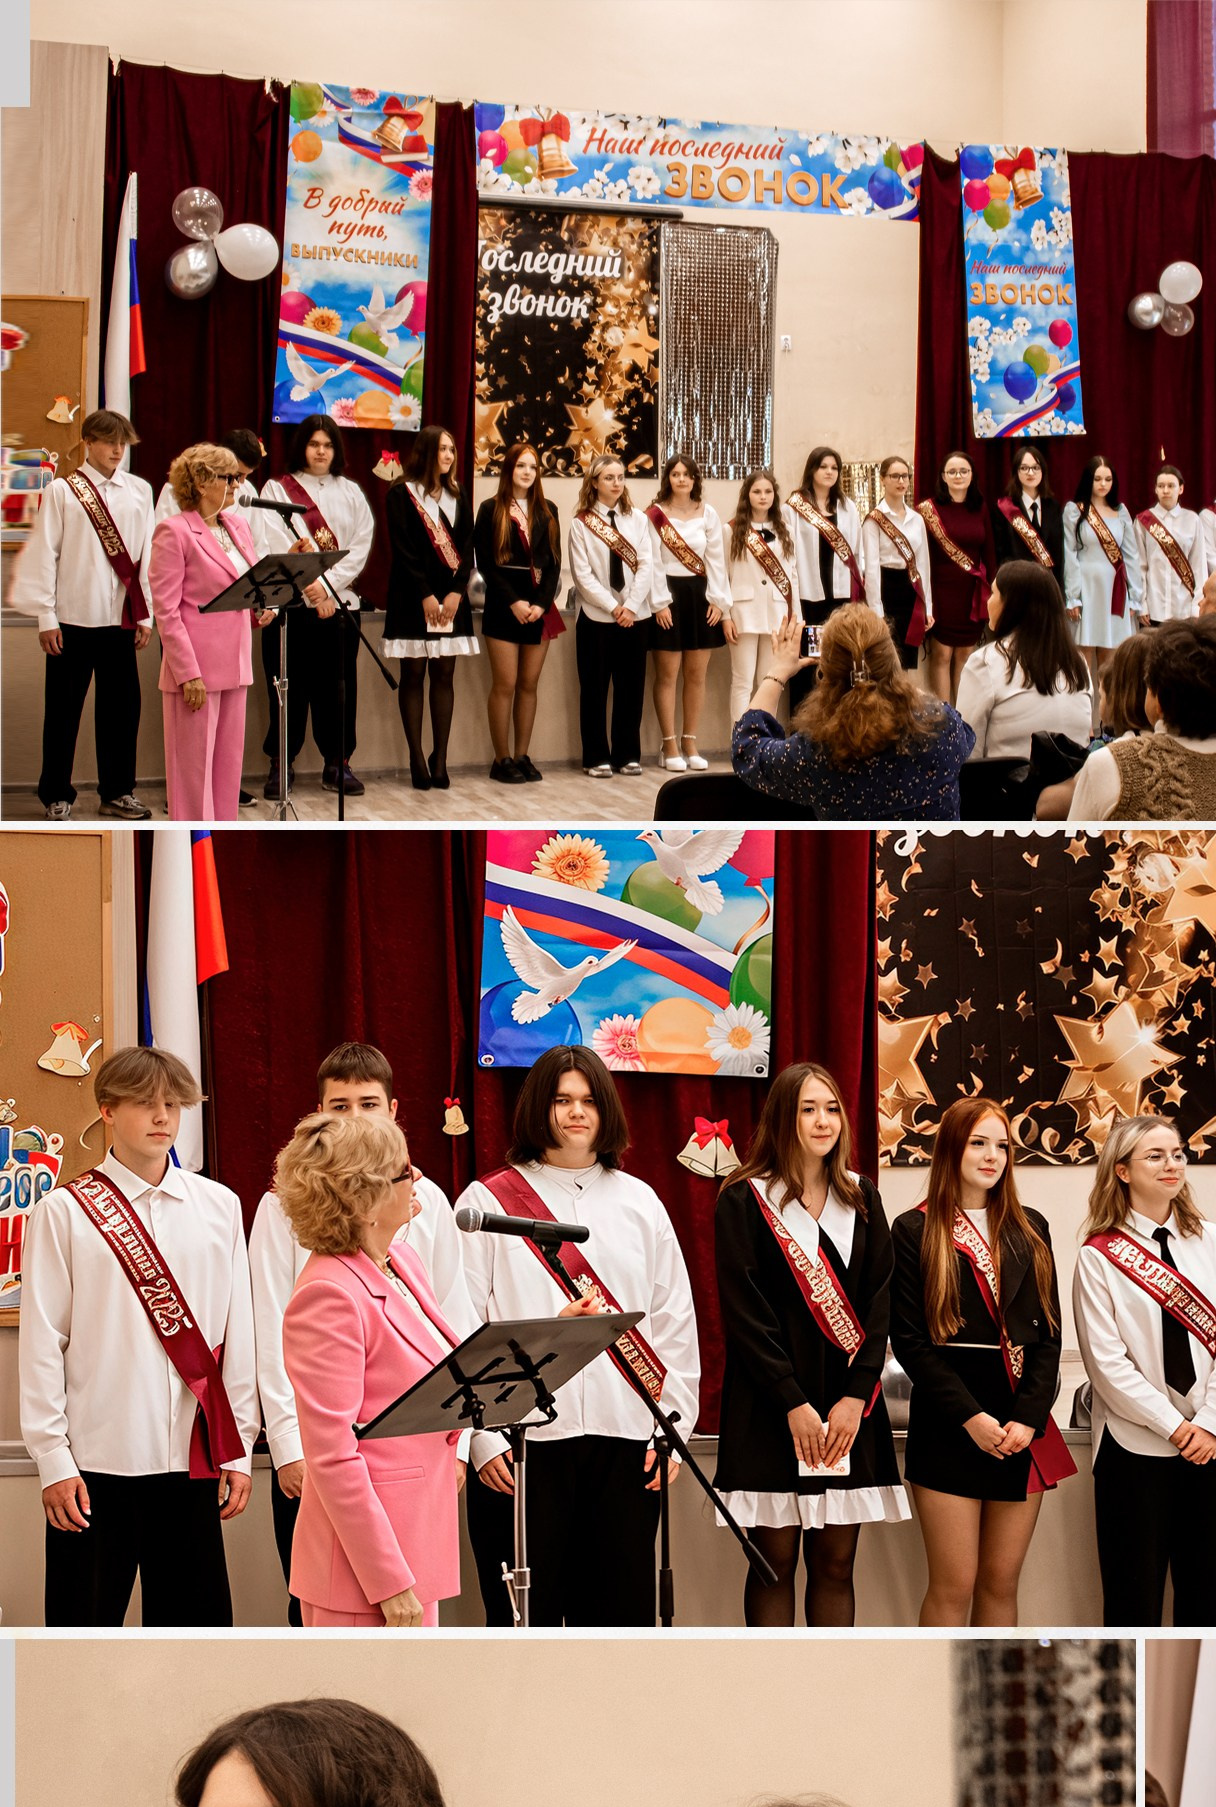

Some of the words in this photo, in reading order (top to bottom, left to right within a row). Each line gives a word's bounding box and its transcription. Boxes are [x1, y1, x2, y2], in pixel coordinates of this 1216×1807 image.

[582, 126, 644, 155] Наш
[649, 136, 788, 169] последний
[663, 161, 850, 209] ЗВОНОК
[303, 187, 324, 210] В
[321, 188, 408, 220] добрый
[328, 220, 388, 244] путь,
[290, 243, 418, 269] ВЫПУСКНИКИ
[970, 260, 1000, 275] Наш
[1003, 261, 1068, 281] последний
[487, 283, 592, 323] звонок
[970, 282, 1073, 305] ЗВОНОК
